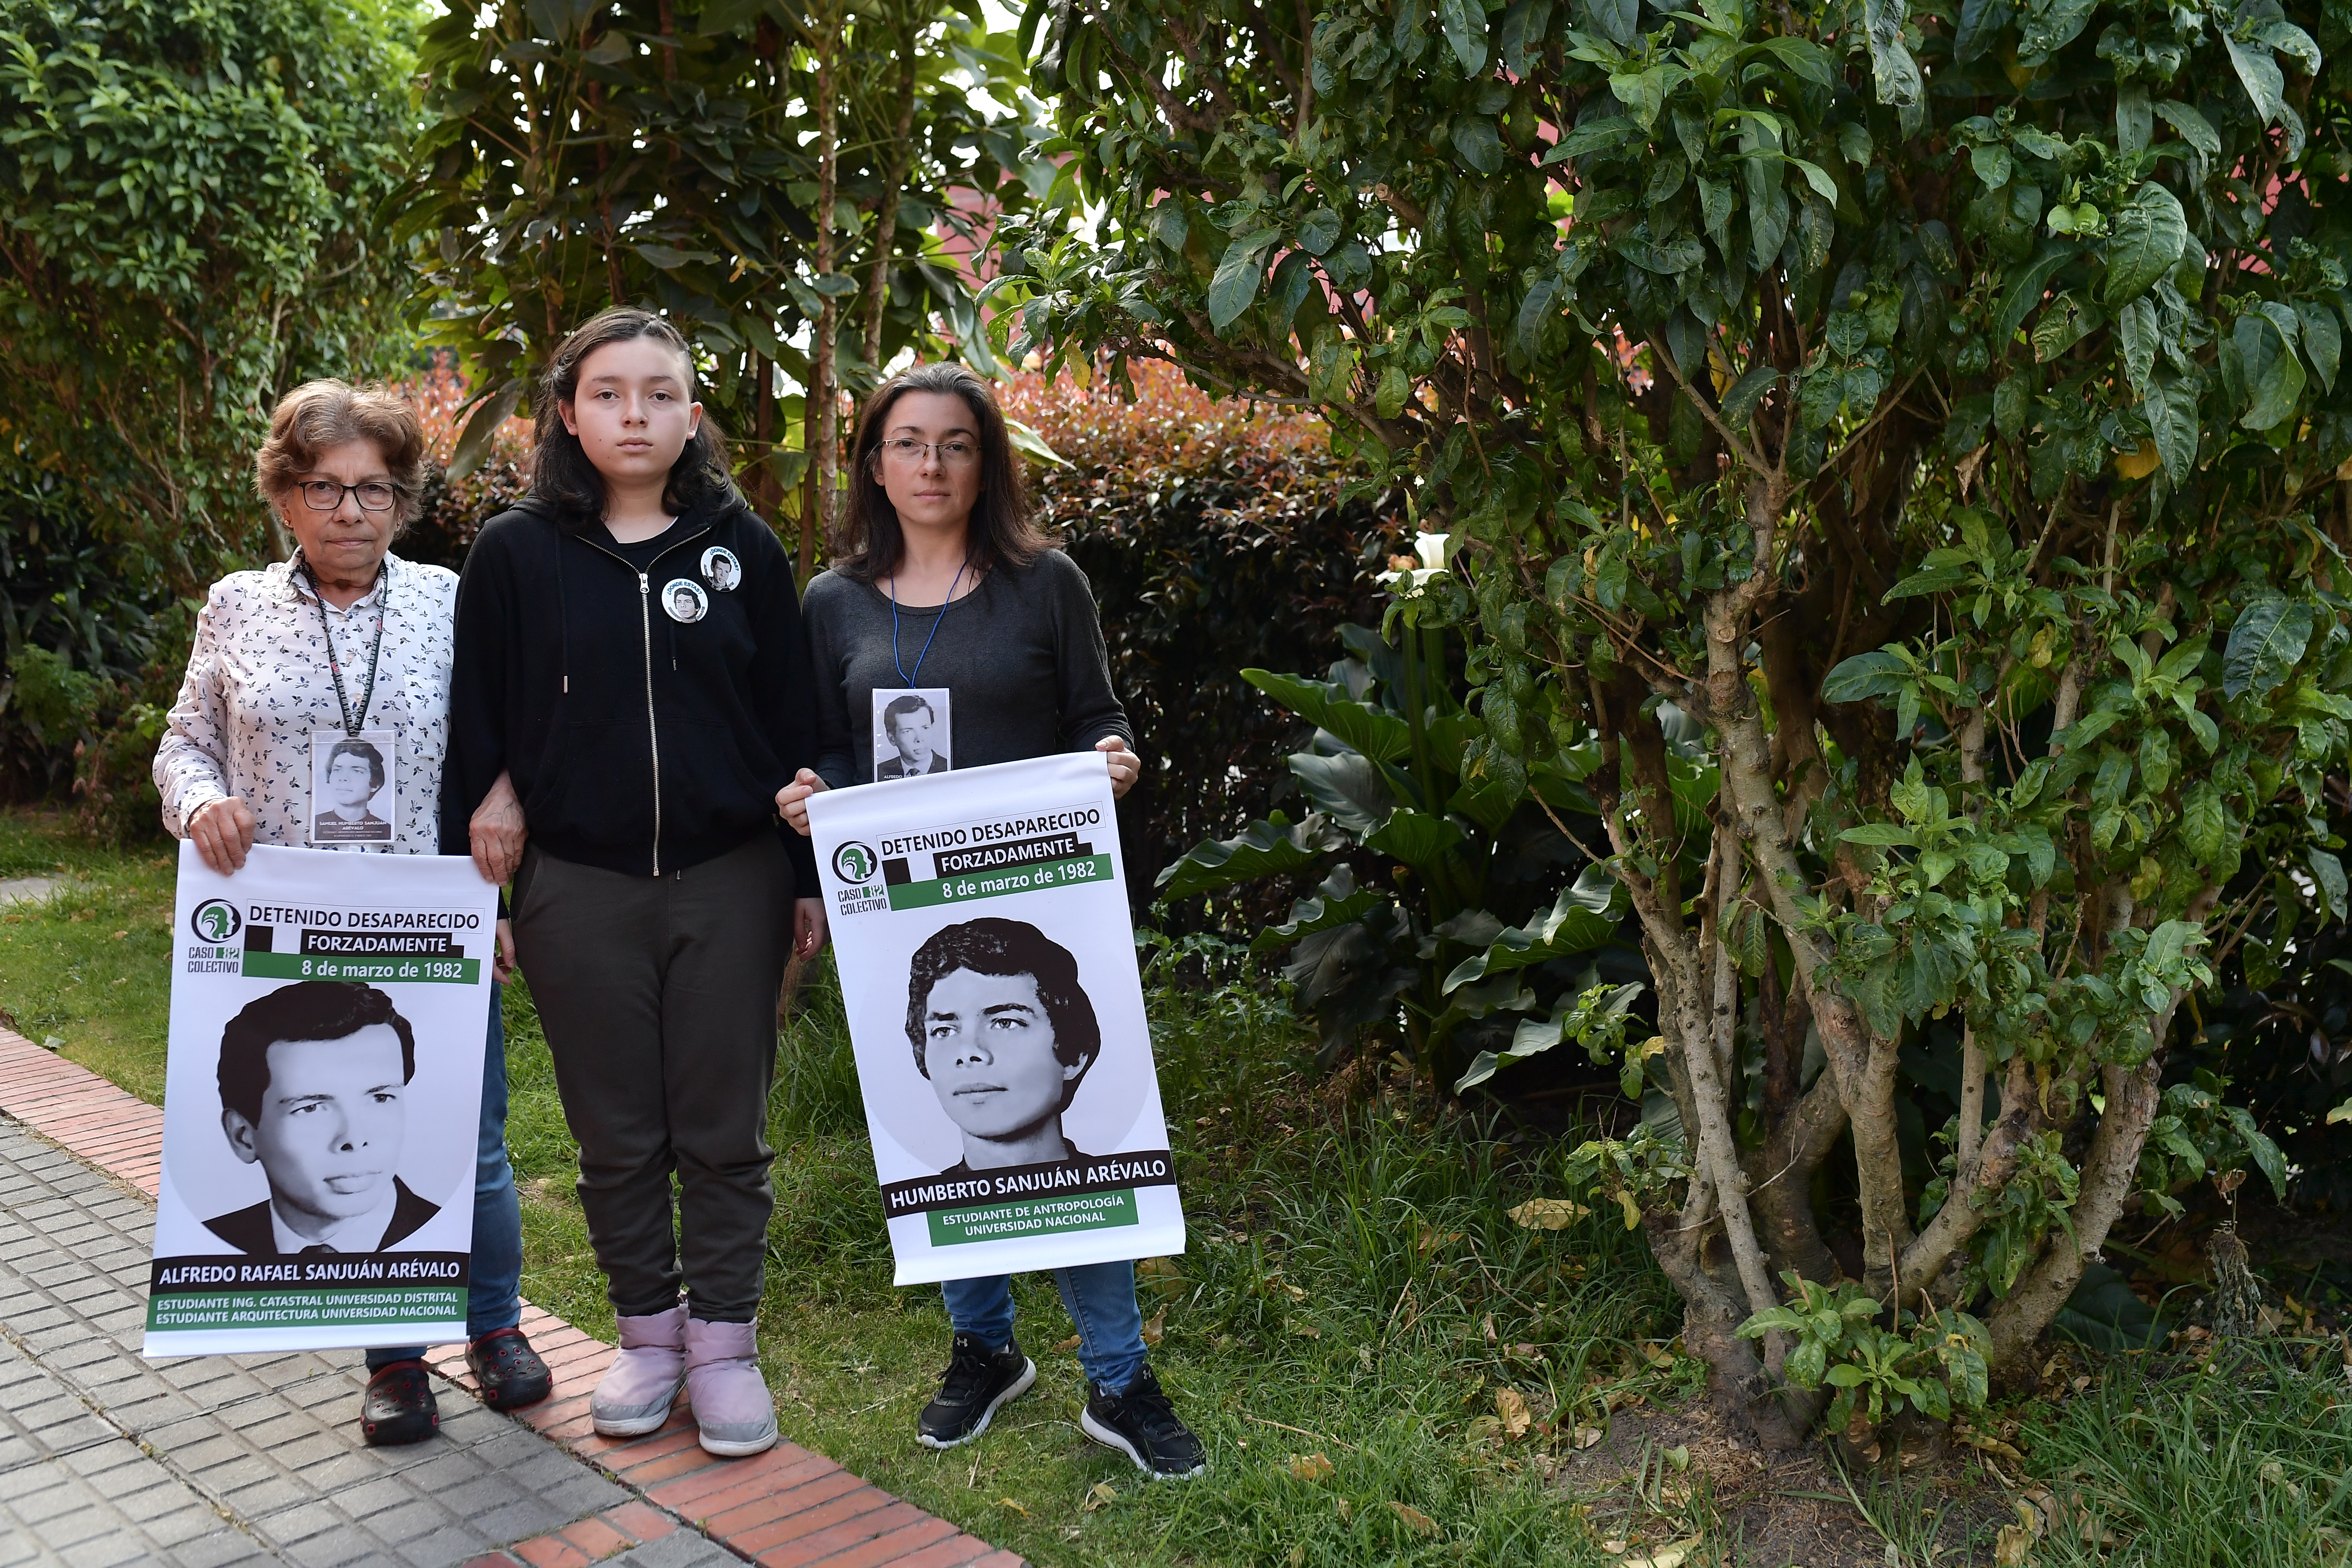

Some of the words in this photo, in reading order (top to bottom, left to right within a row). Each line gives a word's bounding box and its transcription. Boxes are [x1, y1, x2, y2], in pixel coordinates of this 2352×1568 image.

[727, 553, 739, 571] ESTAS?
[667, 581, 683, 595] ¿DONDE
[684, 581, 702, 594] ESTAS?
[881, 829, 966, 855] DETENIDO
[972, 809, 1100, 842] DESAPARECIDO
[941, 838, 1075, 872] FORZADAMENTE
[942, 883, 953, 898] 8
[957, 879, 976, 896] de
[981, 875, 1029, 893] marzo
[1034, 868, 1054, 885] de
[1058, 861, 1096, 880] 1982
[838, 887, 861, 902] CASO
[868, 884, 884, 897] 82
[840, 898, 887, 916] COLECTIVO
[250, 906, 341, 926] DETENIDO
[348, 912, 479, 929] DESAPARECIDO
[308, 935, 447, 952] FORZADAMENTE
[188, 947, 213, 959] CASO
[223, 947, 239, 959] 82
[188, 961, 238, 973] COLECTIVO
[301, 960, 312, 975] 8
[317, 961, 338, 976] de
[342, 965, 394, 977] marzo
[398, 962, 419, 977] de
[424, 962, 462, 978] 1982
[890, 1179, 991, 1209] HUMBERTO
[995, 1166, 1081, 1194] SANJUÁN
[1086, 1160, 1166, 1184] ARÉVALO
[943, 1209, 1013, 1225] ESTUDIANTE
[1015, 1206, 1031, 1217] DE
[1033, 1195, 1124, 1215] ANTROPOLOGÍA
[965, 1219, 1042, 1236] UNIVERSIDAD
[1045, 1211, 1106, 1227] NACIONAL
[158, 1266, 236, 1285] ALFREDO
[241, 1265, 302, 1282] RAFAEL
[305, 1259, 384, 1280] SANJUÁN
[387, 1258, 460, 1278] ARÉVALO
[157, 1298, 229, 1310] ESTUDIANTE
[232, 1297, 256, 1308] ING.
[259, 1295, 323, 1307] CATASTRAL
[326, 1293, 401, 1305] UNIVERSIDAD
[404, 1292, 458, 1304] DISTRITAL
[156, 1311, 229, 1324] ESTUDIANTE
[231, 1309, 318, 1322] ARQUITECTURA
[321, 1307, 397, 1319] UNIVERSIDAD
[400, 1305, 457, 1317] NACIONAL
